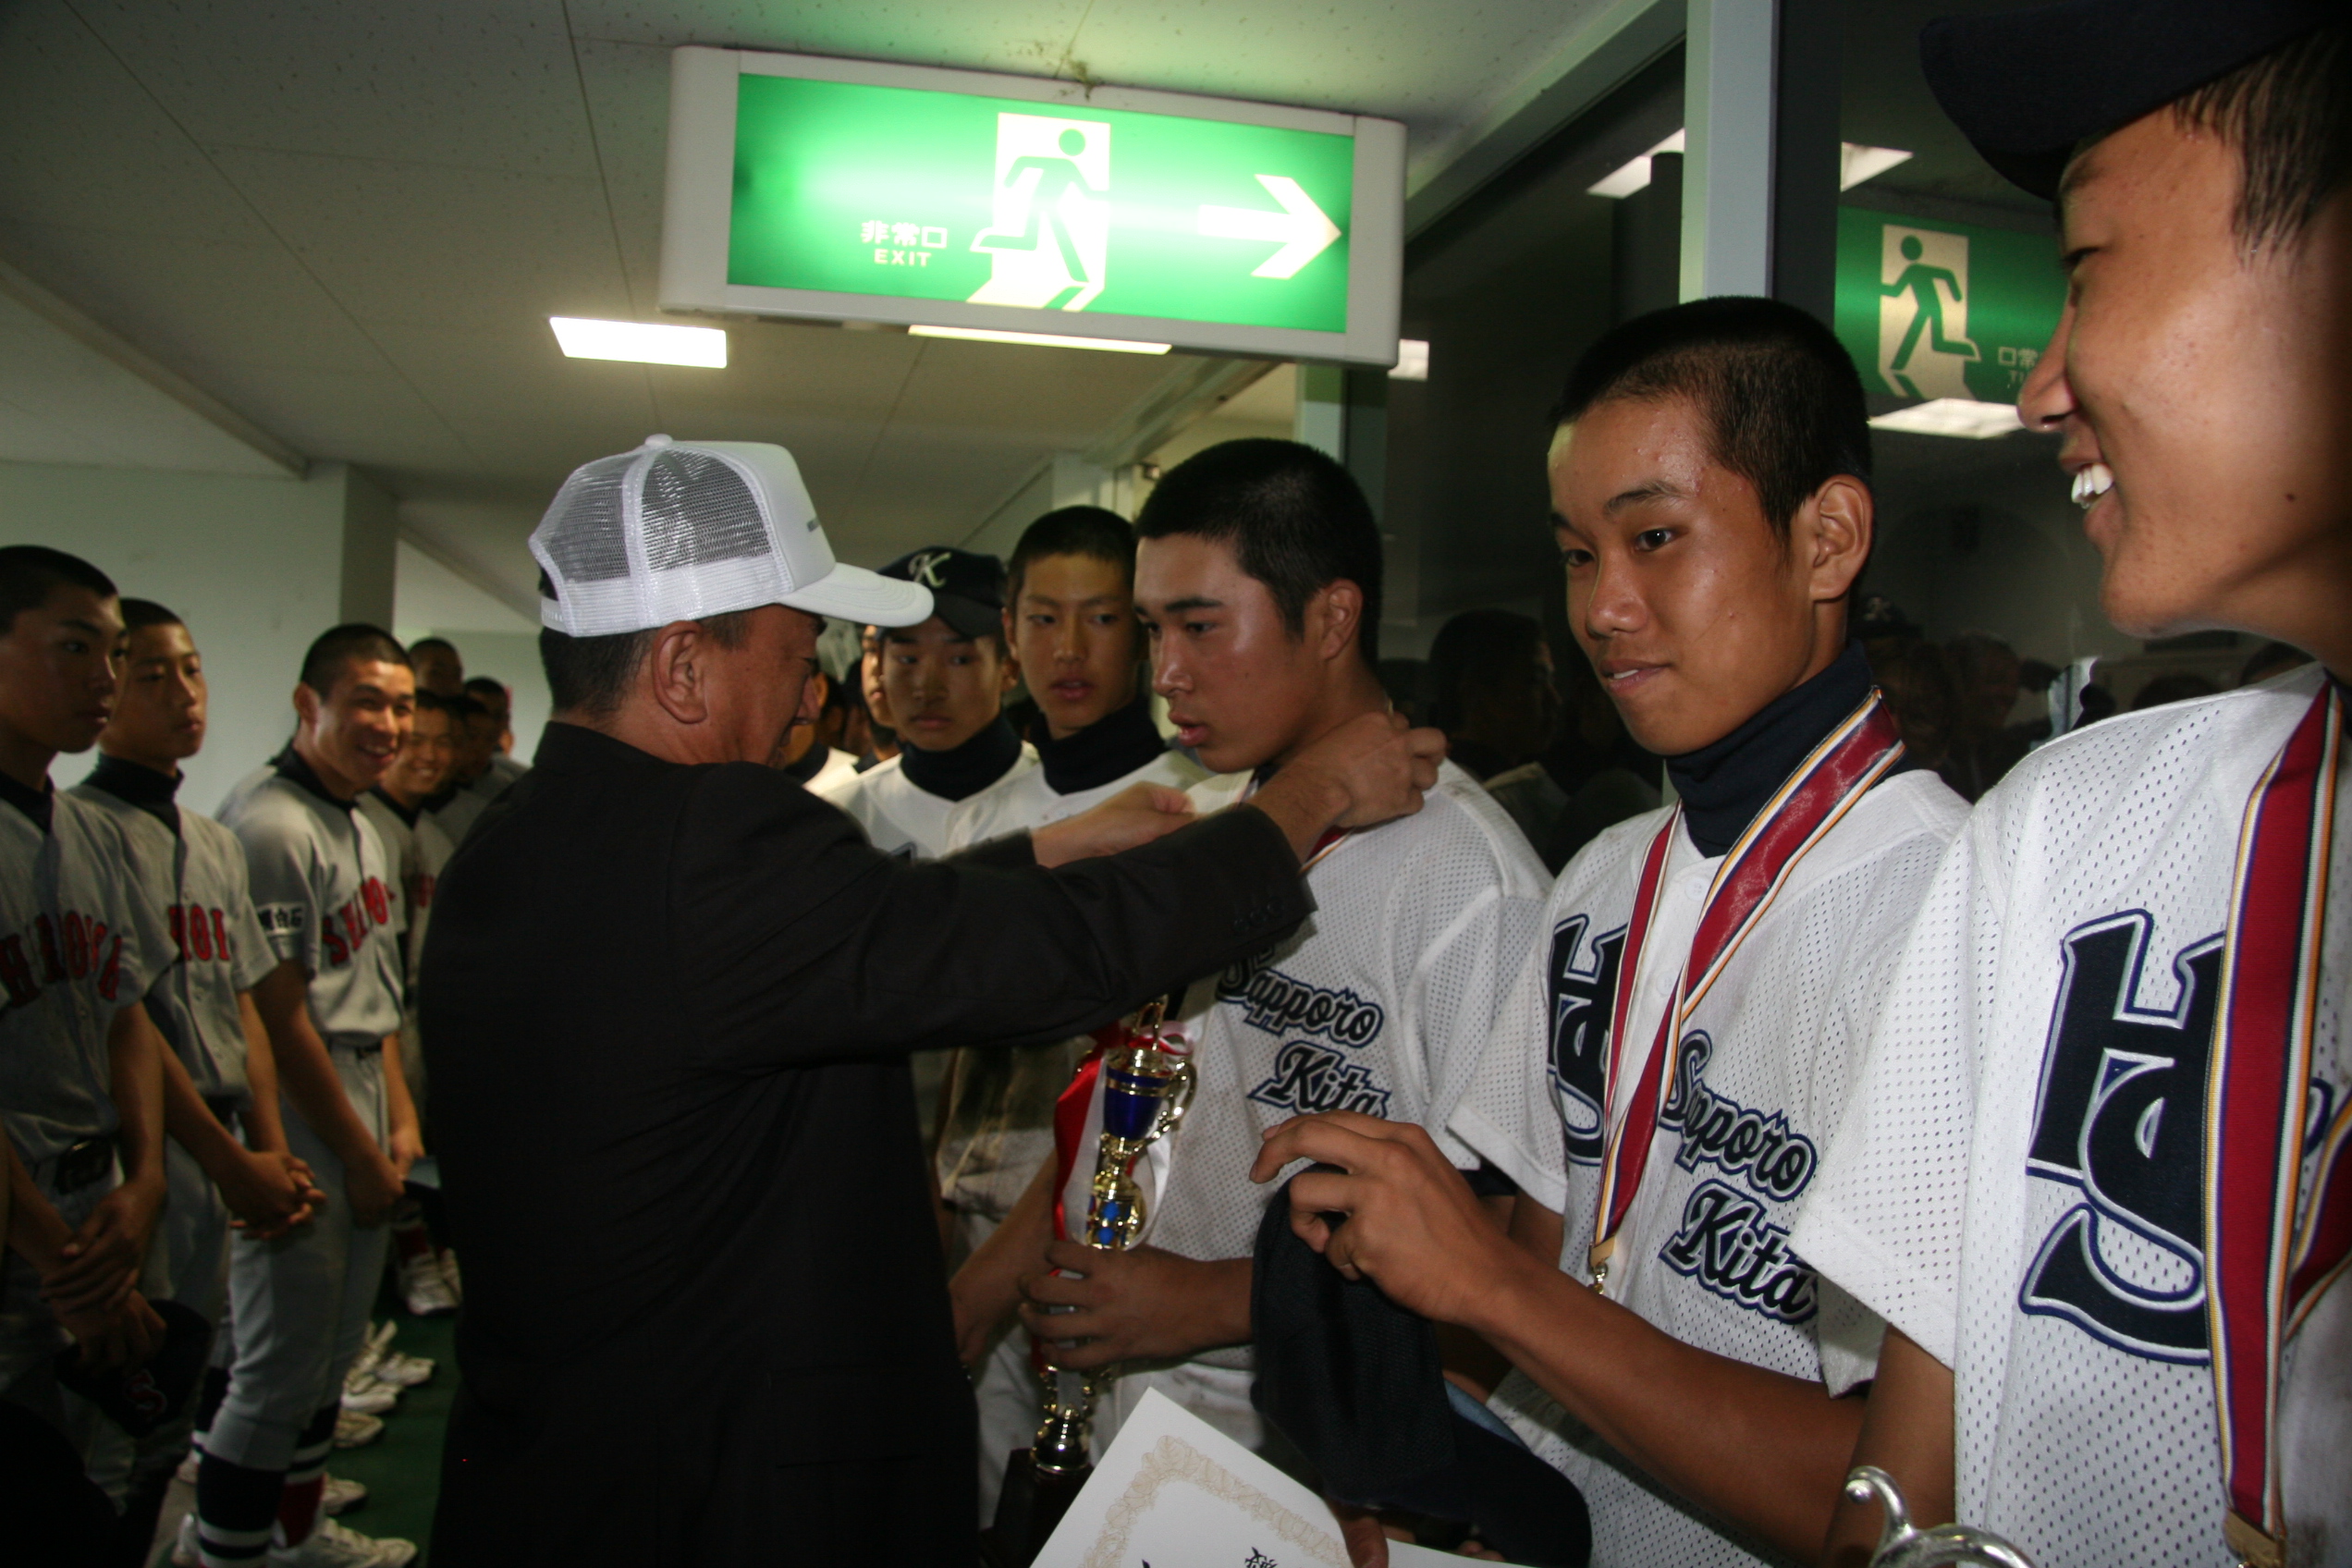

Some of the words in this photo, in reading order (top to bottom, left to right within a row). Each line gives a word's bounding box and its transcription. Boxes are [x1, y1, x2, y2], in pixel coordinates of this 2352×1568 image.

[861, 220, 948, 249] 非常口
[874, 248, 932, 266] EXIT
[907, 552, 951, 588] K
[1247, 1040, 1391, 1119] Kita
[1658, 1178, 1819, 1325] Kita
